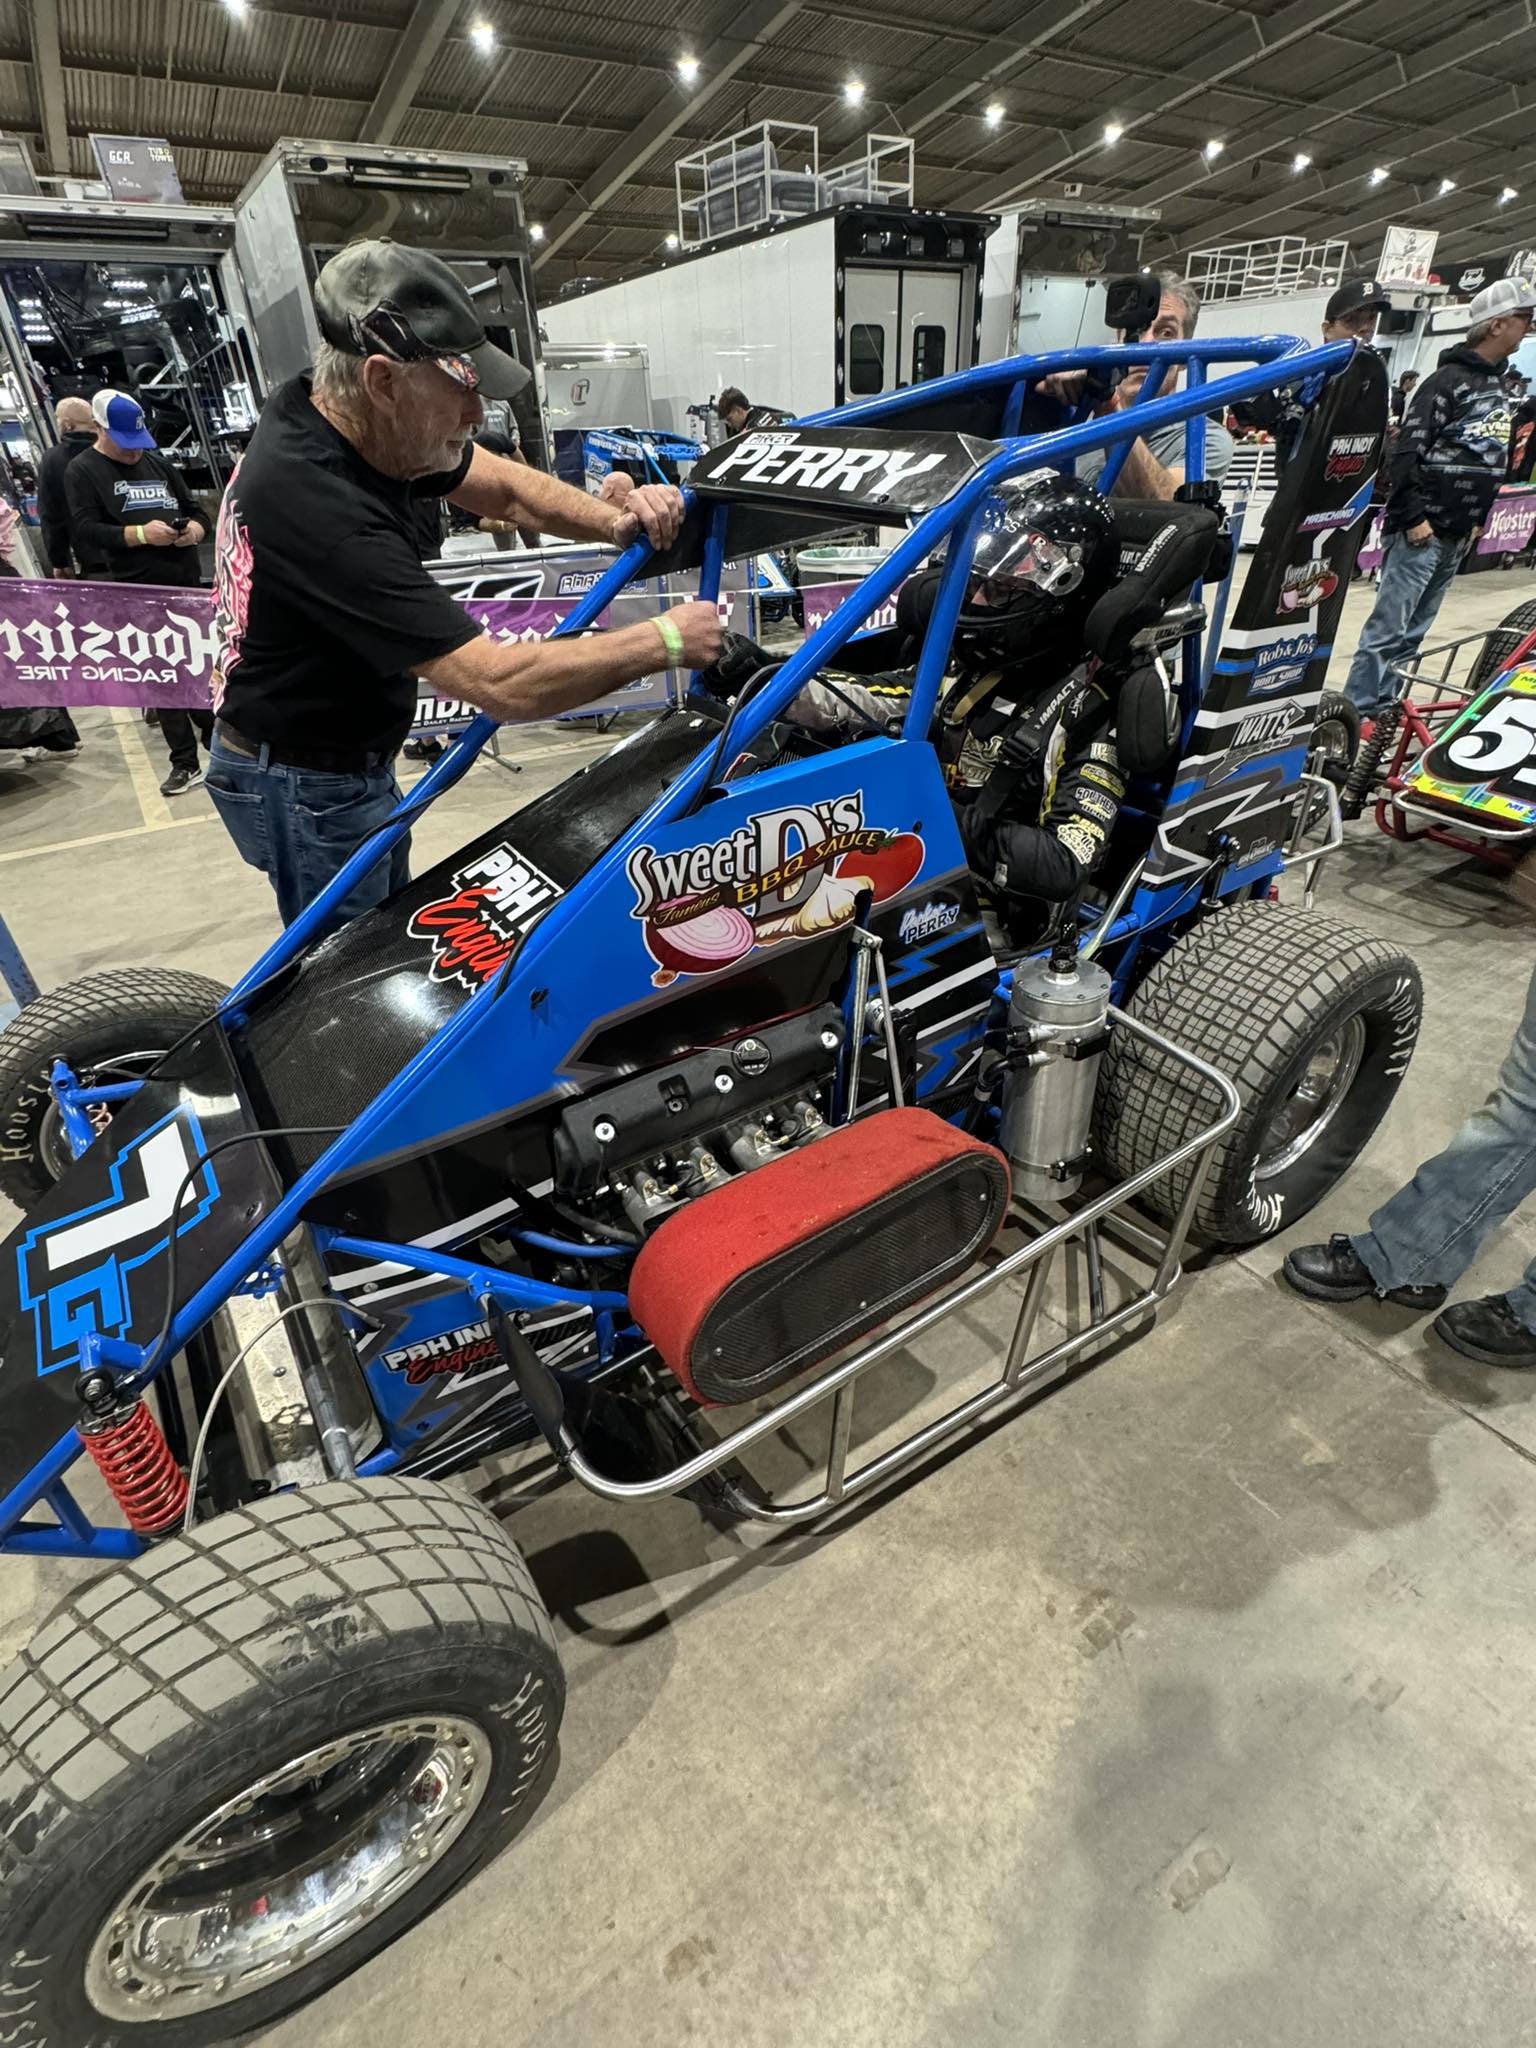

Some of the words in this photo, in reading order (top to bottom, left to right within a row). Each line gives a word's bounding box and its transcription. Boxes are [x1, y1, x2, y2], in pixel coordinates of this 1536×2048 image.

[1351, 437, 1376, 453] INDY
[706, 444, 948, 495] PERRY
[1303, 507, 1355, 526] MASCHINO
[1258, 643, 1283, 667] Rob
[1040, 679, 1077, 726] IMPACT
[1233, 706, 1296, 747] WATTS
[462, 848, 552, 923] PBH
[625, 826, 757, 918] Sweet
[653, 891, 721, 926] Famous
[736, 856, 809, 904] BBQ
[814, 831, 880, 863] SAUCE
[905, 904, 960, 944] PERRY
[385, 1335, 453, 1371] PBH
